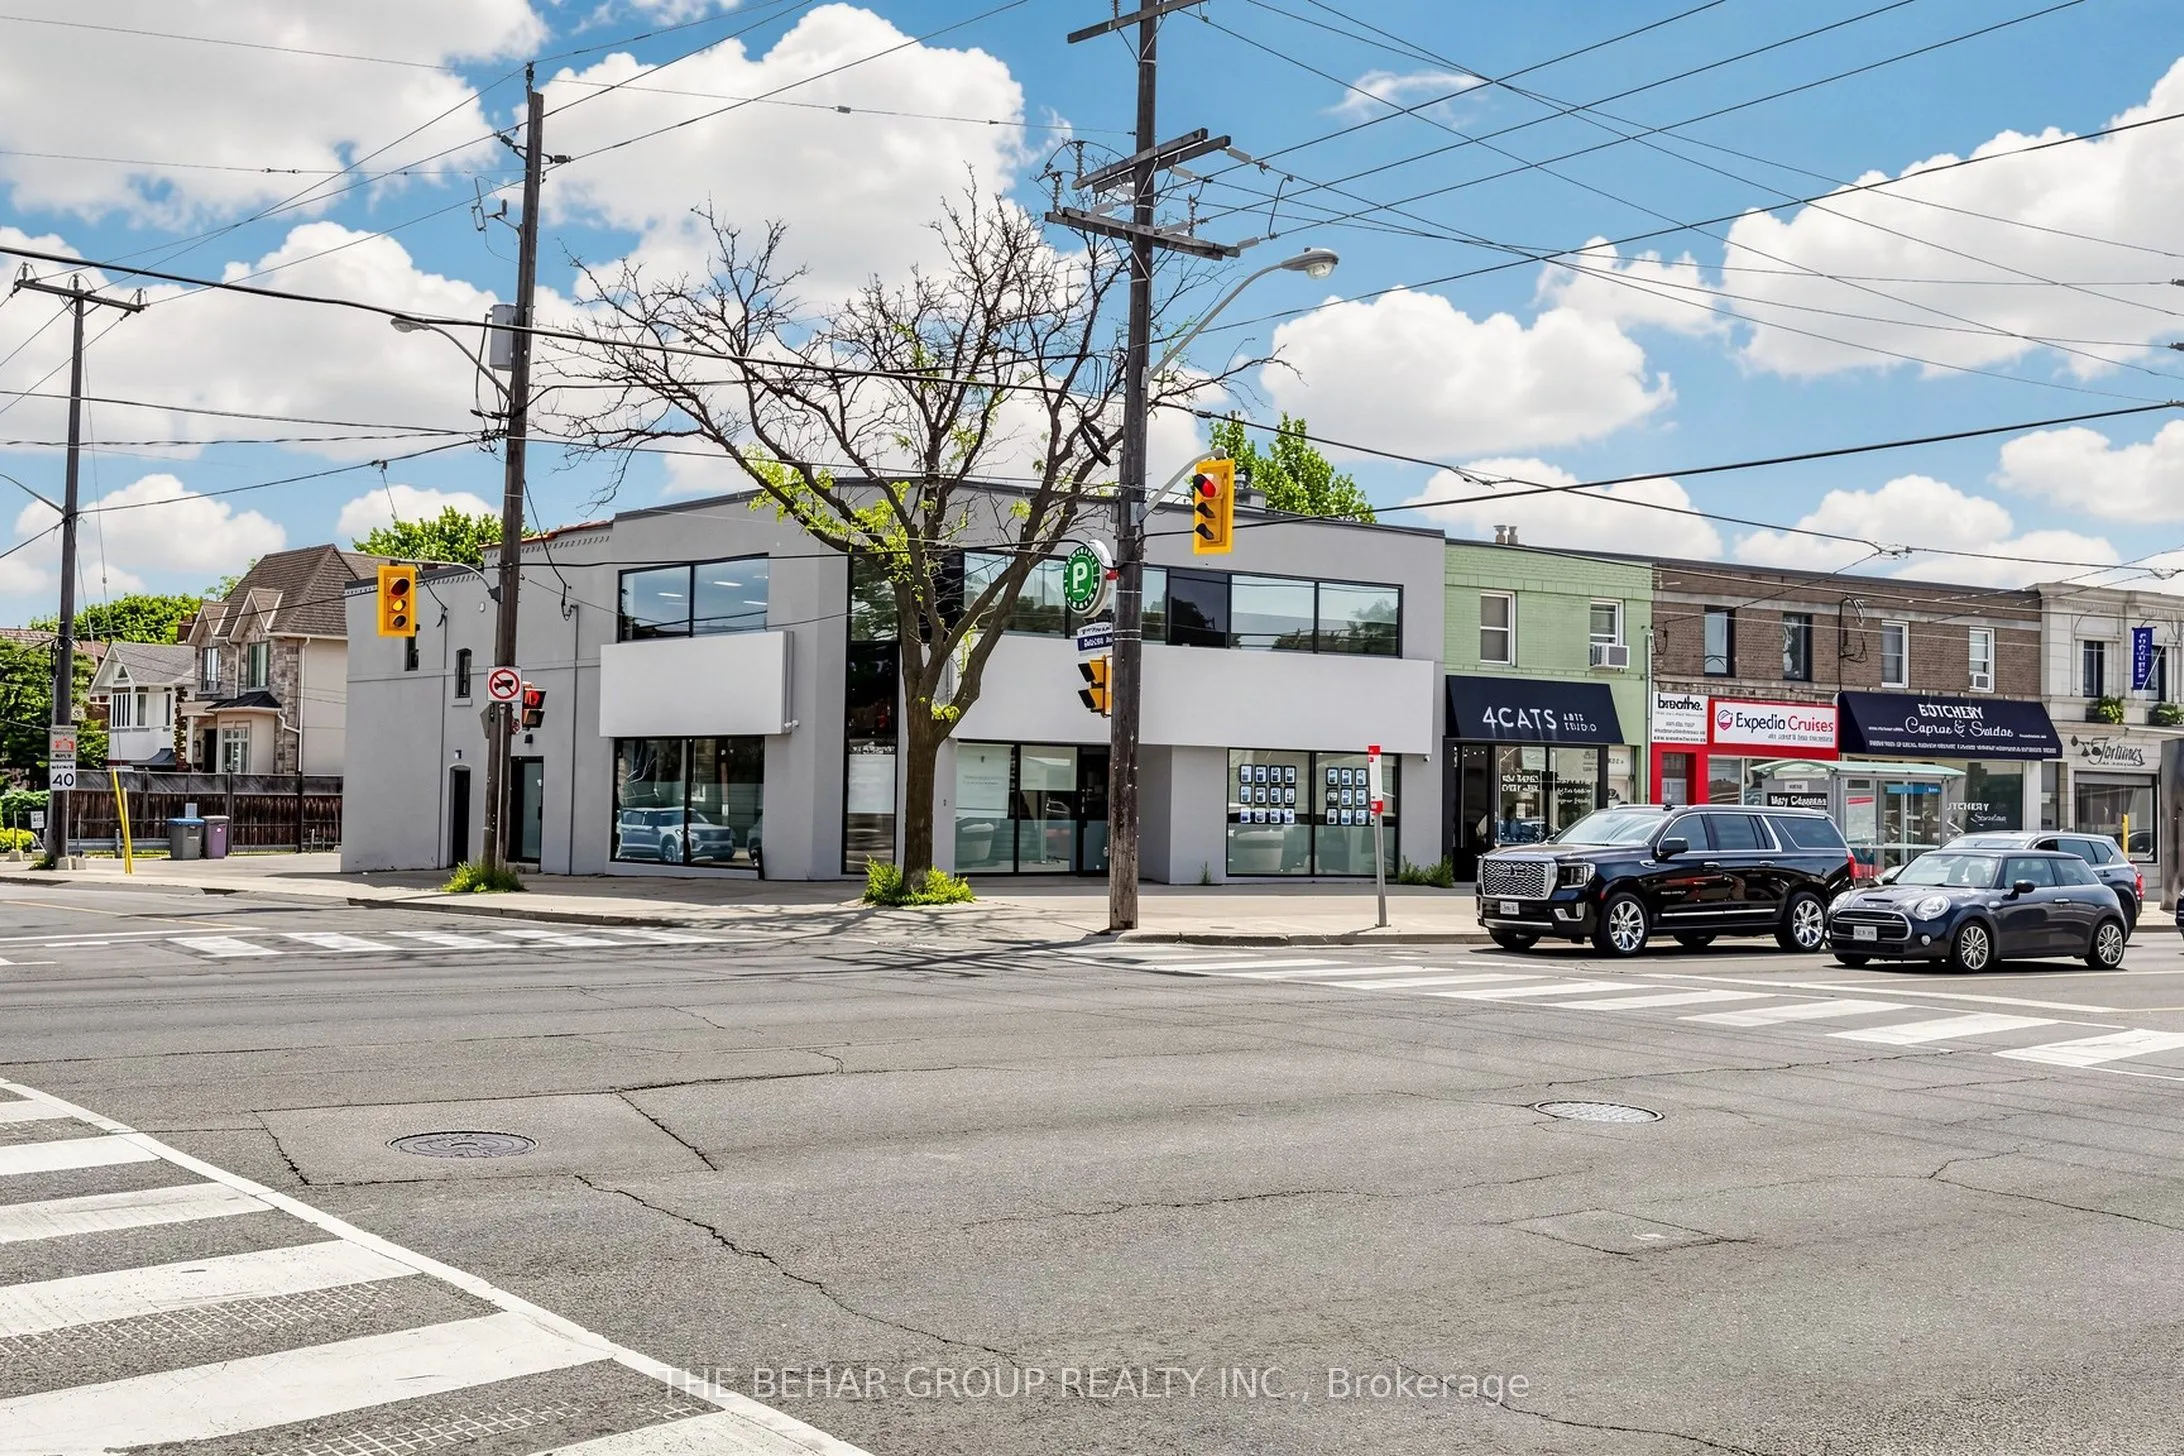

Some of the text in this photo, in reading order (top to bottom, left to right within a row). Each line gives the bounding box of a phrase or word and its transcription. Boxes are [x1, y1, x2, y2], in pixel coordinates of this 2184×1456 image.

[1072, 561, 1088, 590] P
[1657, 693, 1703, 710] breathe.
[1482, 706, 1557, 729] 4CATS
[1736, 712, 1834, 734] Expedia Cruises
[52, 773, 74, 787] 40
